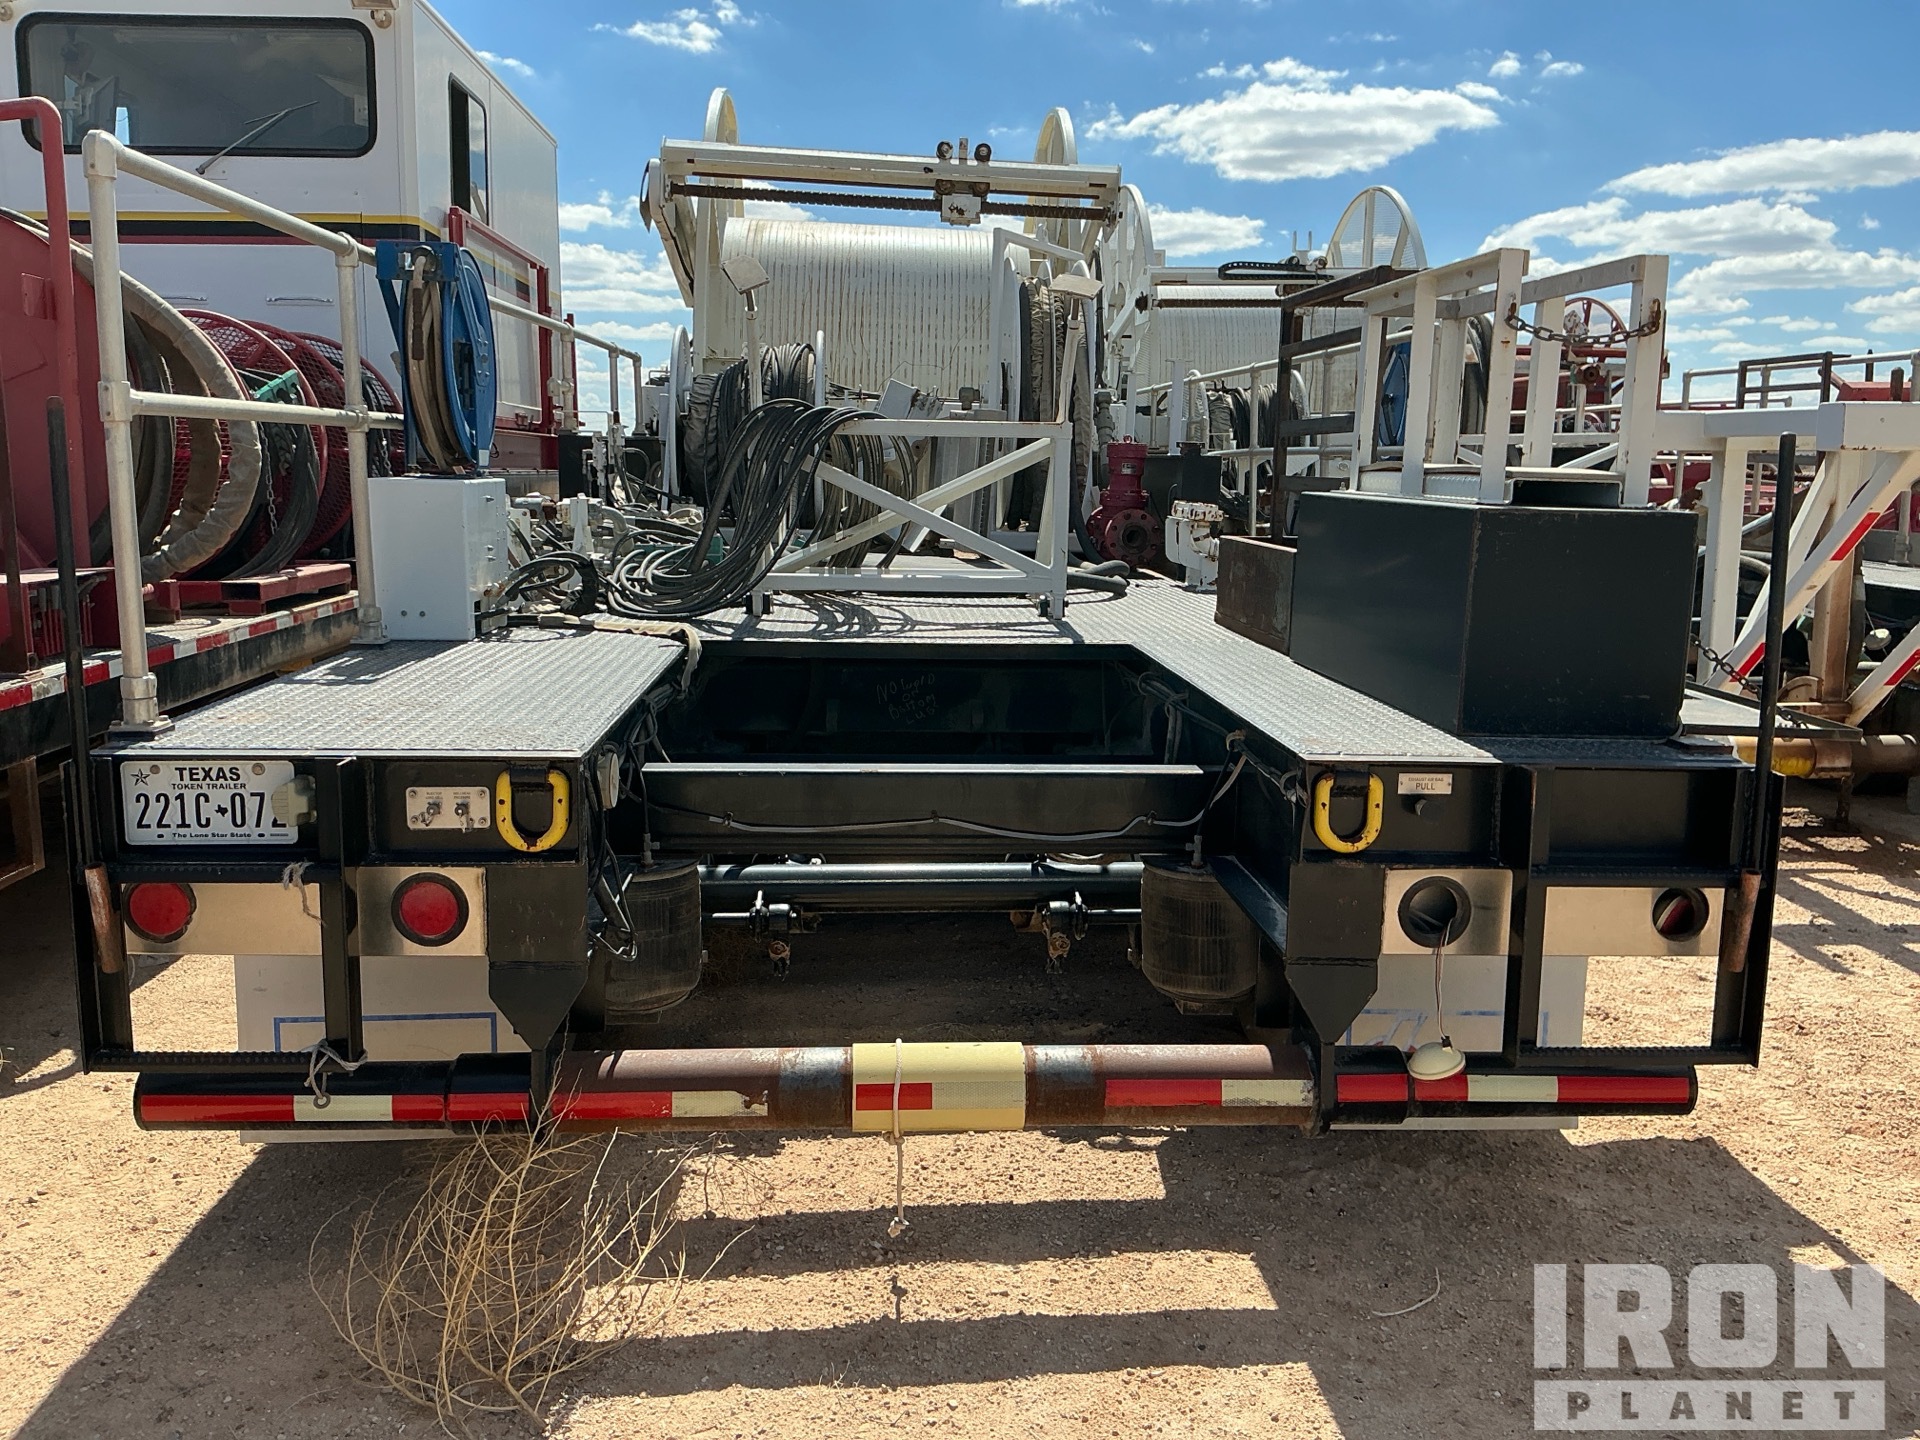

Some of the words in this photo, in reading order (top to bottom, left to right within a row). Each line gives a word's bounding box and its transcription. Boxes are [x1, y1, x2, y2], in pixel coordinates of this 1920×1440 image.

[174, 767, 241, 782] TEXAS
[1415, 782, 1436, 790] PULL
[135, 792, 211, 829] 221C
[230, 791, 287, 829] 07
